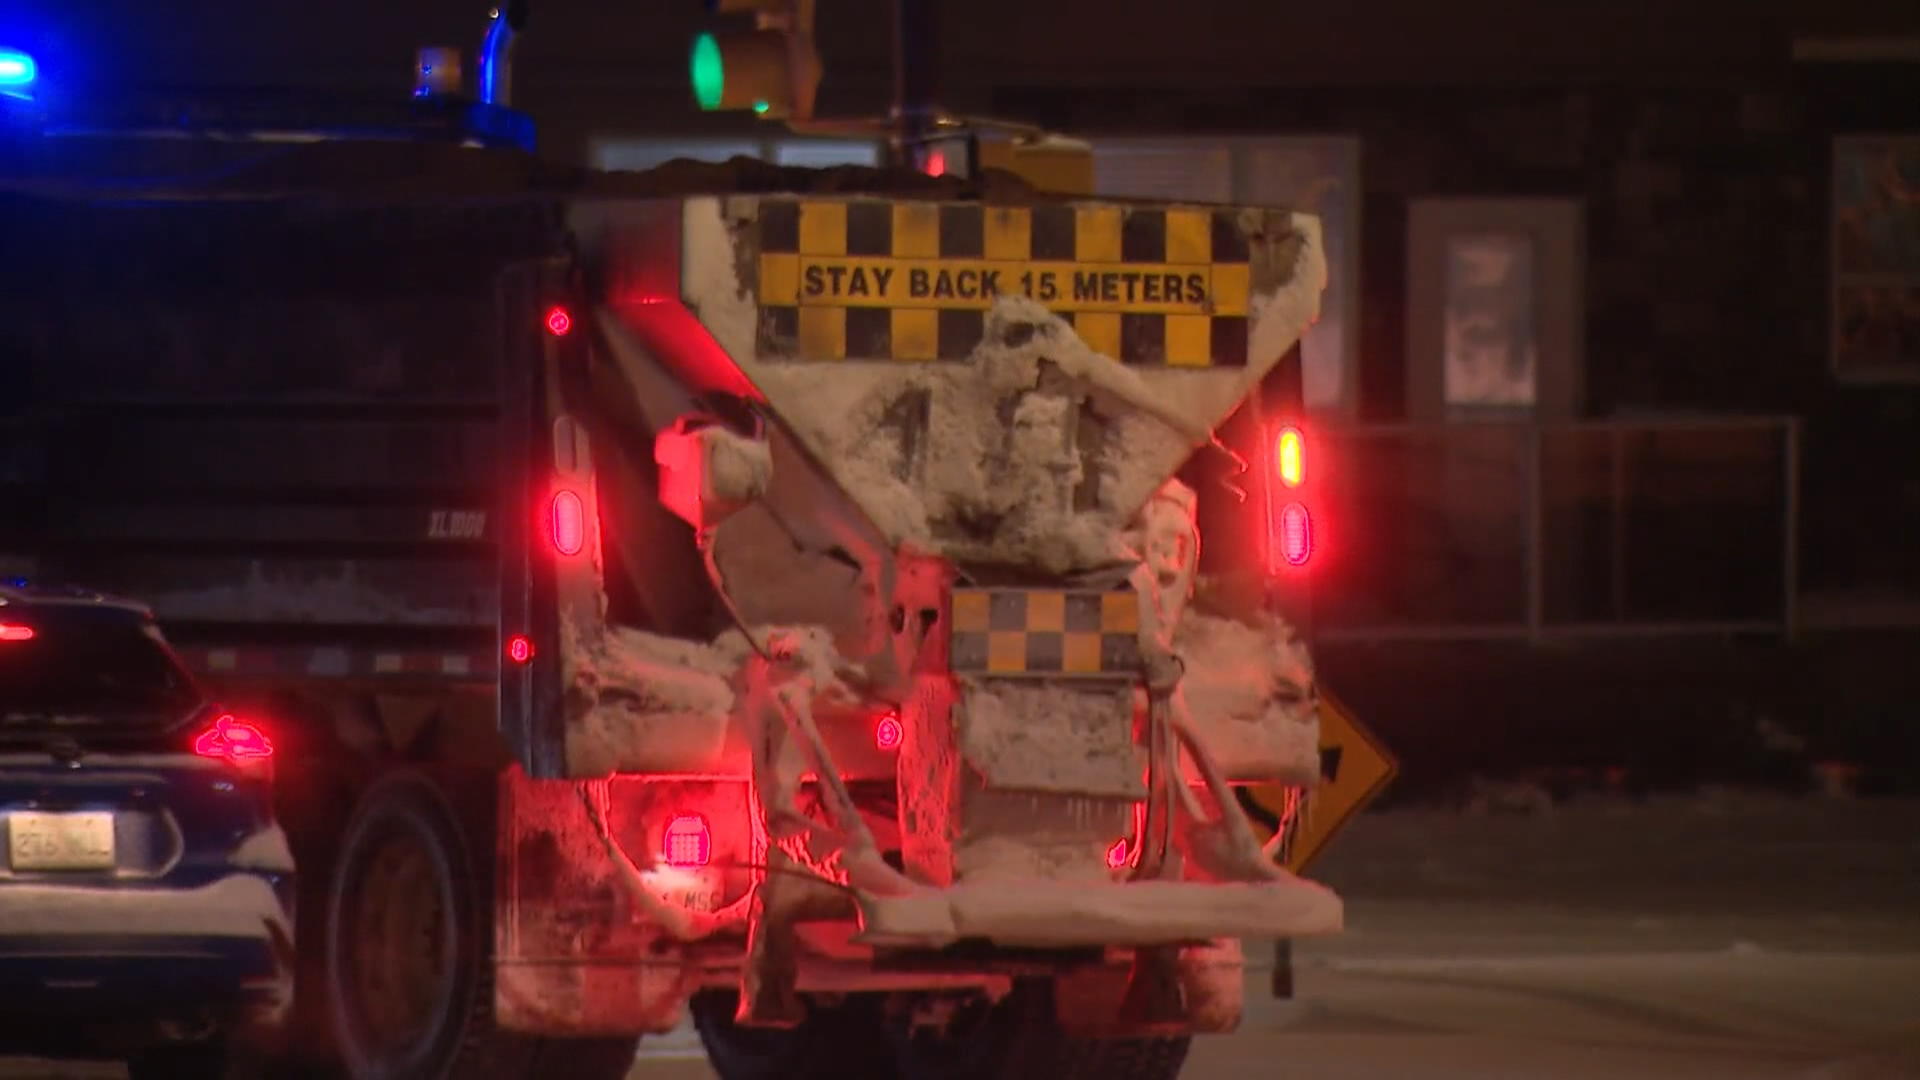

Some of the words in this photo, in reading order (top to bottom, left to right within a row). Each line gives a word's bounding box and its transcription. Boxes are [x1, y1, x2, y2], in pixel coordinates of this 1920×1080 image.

[804, 265, 894, 297] STAY
[909, 267, 1001, 300] BACK
[1074, 272, 1206, 303] METERS
